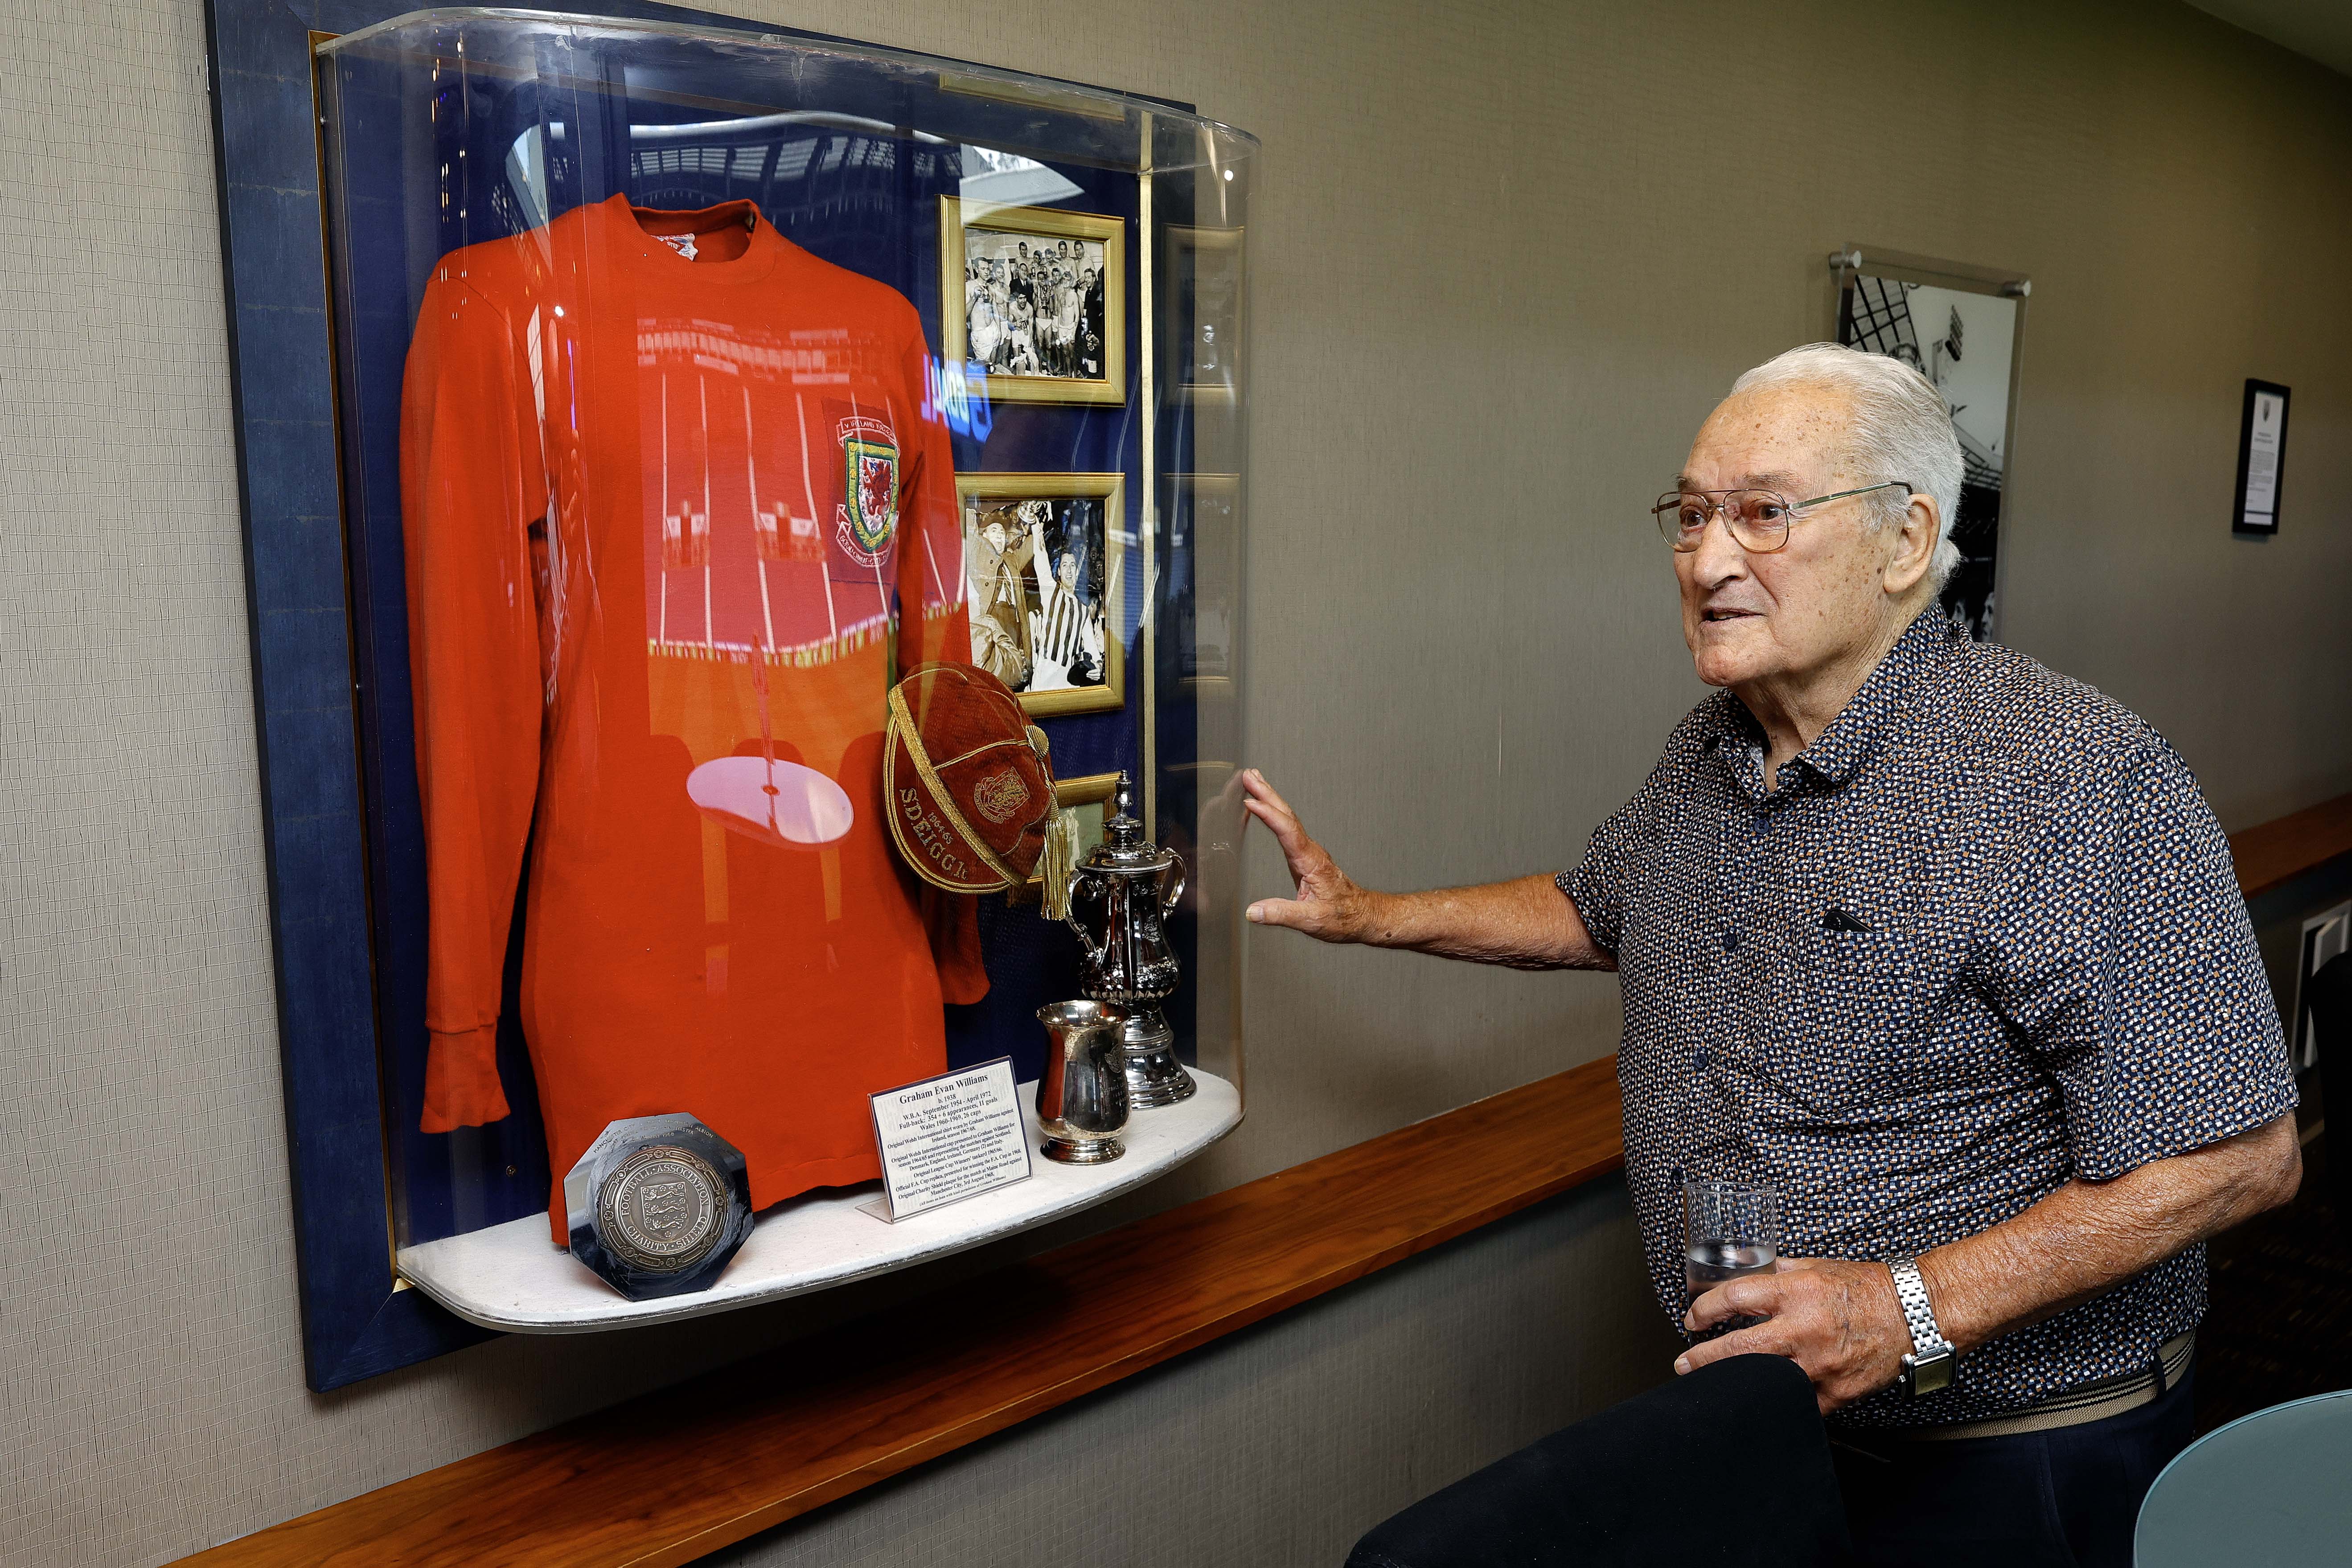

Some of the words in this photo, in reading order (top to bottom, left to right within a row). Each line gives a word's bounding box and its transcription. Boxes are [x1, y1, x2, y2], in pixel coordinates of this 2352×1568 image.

[850, 419, 874, 428] IRELAND
[899, 1090, 933, 1104] Graham
[933, 1084, 955, 1096] Evan
[955, 1074, 989, 1089] Williams
[944, 1093, 956, 1102] 1938
[902, 1111, 922, 1121] W.B.A.
[922, 1104, 950, 1116] September
[950, 1099, 963, 1109] 1954
[964, 1094, 980, 1104] April
[979, 1090, 992, 1099] 1972
[927, 1113, 937, 1122] 354
[985, 1096, 998, 1106] goals
[695, 1126, 714, 1138] ALBION
[887, 1140, 905, 1149] Original
[904, 1136, 918, 1145] Welsh
[917, 1128, 943, 1141] International
[968, 1117, 985, 1126] Graham
[983, 1112, 1001, 1121] Williams
[1000, 1108, 1014, 1116] against
[919, 1122, 936, 1131] Wales
[963, 1111, 970, 1119] 26
[970, 1109, 981, 1117] caps
[891, 1153, 909, 1164] Original
[907, 1150, 922, 1158] Welsh
[921, 1142, 947, 1155] International
[954, 1134, 973, 1146] presented
[977, 1129, 993, 1138] Graham
[992, 1124, 1010, 1133] Williams
[927, 1152, 936, 1160] and
[935, 1146, 960, 1157] representing
[965, 1139, 982, 1148] matches
[981, 1134, 995, 1143] against
[946, 1131, 961, 1139] season
[962, 1145, 981, 1155] Germany
[895, 1183, 911, 1192] Official
[944, 1166, 963, 1178] presented
[969, 1161, 985, 1170] winning
[913, 1168, 931, 1178] Original
[930, 1165, 945, 1174] League
[972, 1150, 988, 1160] tankard
[621, 1169, 653, 1216] FOOTBALL
[657, 1164, 709, 1205] ASSOCIATION
[898, 1190, 916, 1200] Original
[915, 1186, 931, 1194] Charity
[931, 1181, 944, 1190] Shield
[943, 1178, 957, 1187] plaque
[969, 1169, 982, 1178] match
[986, 1164, 999, 1172] Maine
[998, 1160, 1010, 1168] Road
[1009, 1156, 1022, 1165] against
[930, 1185, 954, 1197] Manchester
[963, 1178, 971, 1186] 3rd
[970, 1174, 985, 1184] August
[627, 1226, 669, 1251] CHARITY
[676, 1216, 707, 1248] SHIELD
